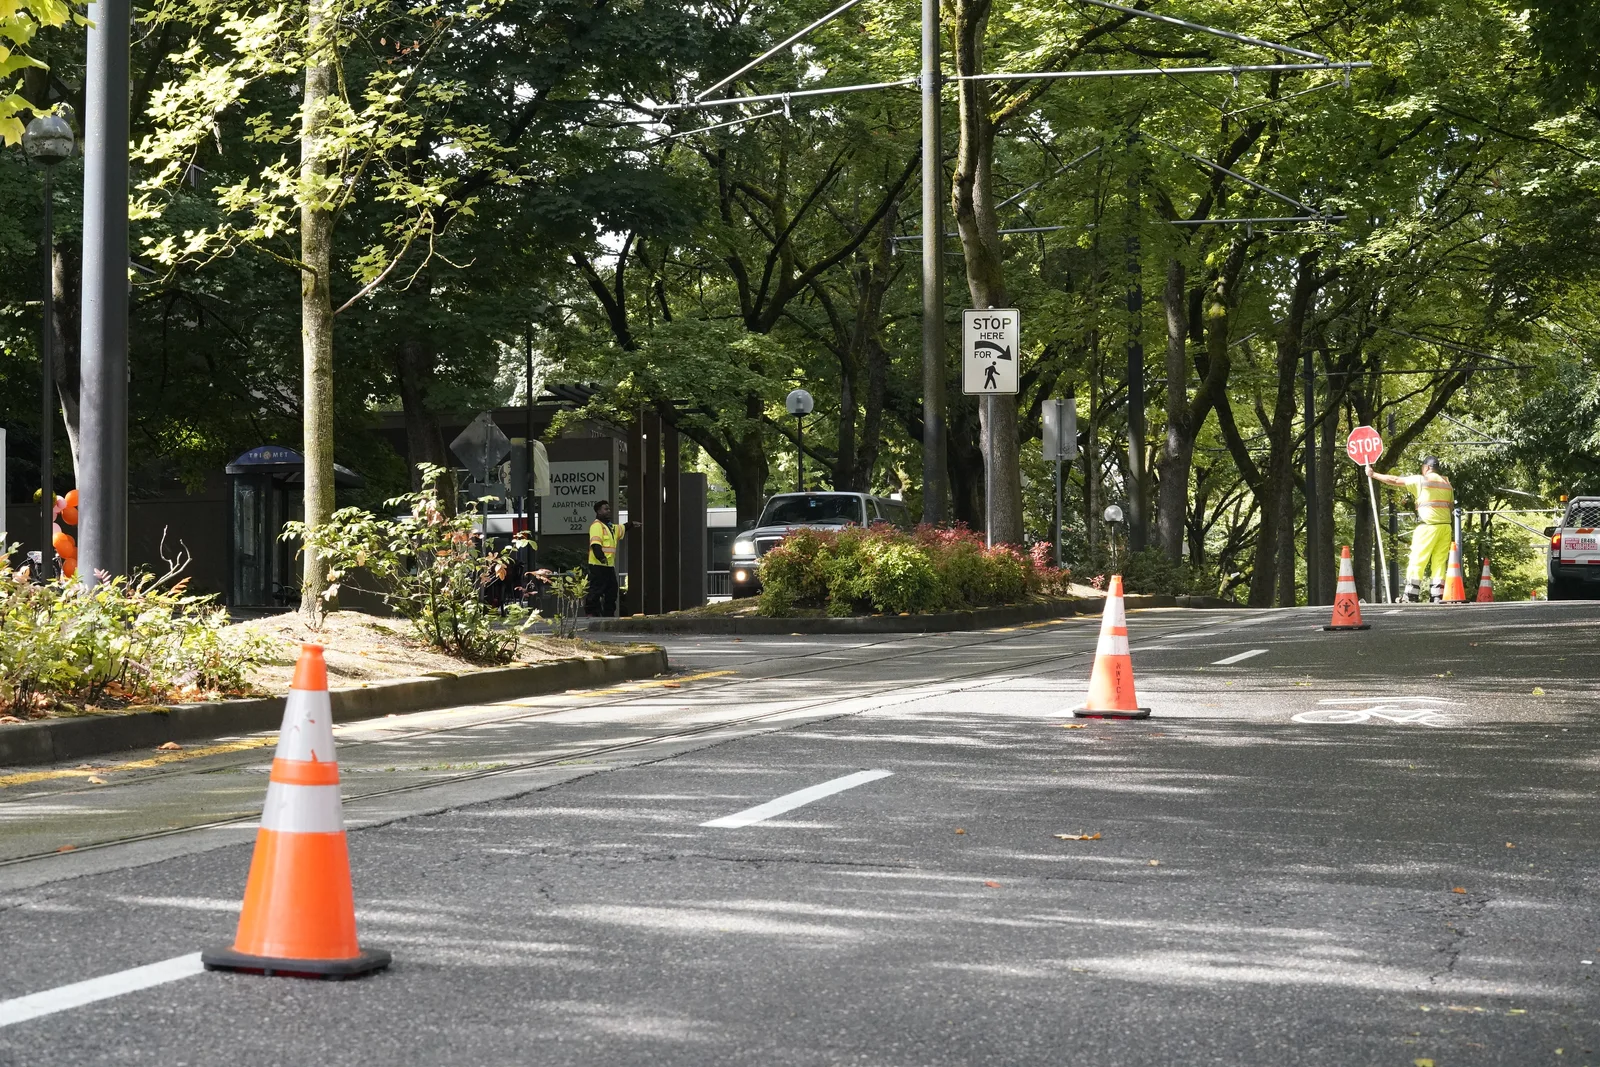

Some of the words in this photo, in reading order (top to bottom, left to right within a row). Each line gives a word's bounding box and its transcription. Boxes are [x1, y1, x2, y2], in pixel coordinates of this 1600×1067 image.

[973, 318, 1011, 330] STOP
[980, 332, 1004, 340] HERE
[974, 351, 992, 359] FOR
[1349, 437, 1380, 455] STOP
[553, 485, 596, 496] TOWER
[552, 500, 598, 508] APARTMENT
